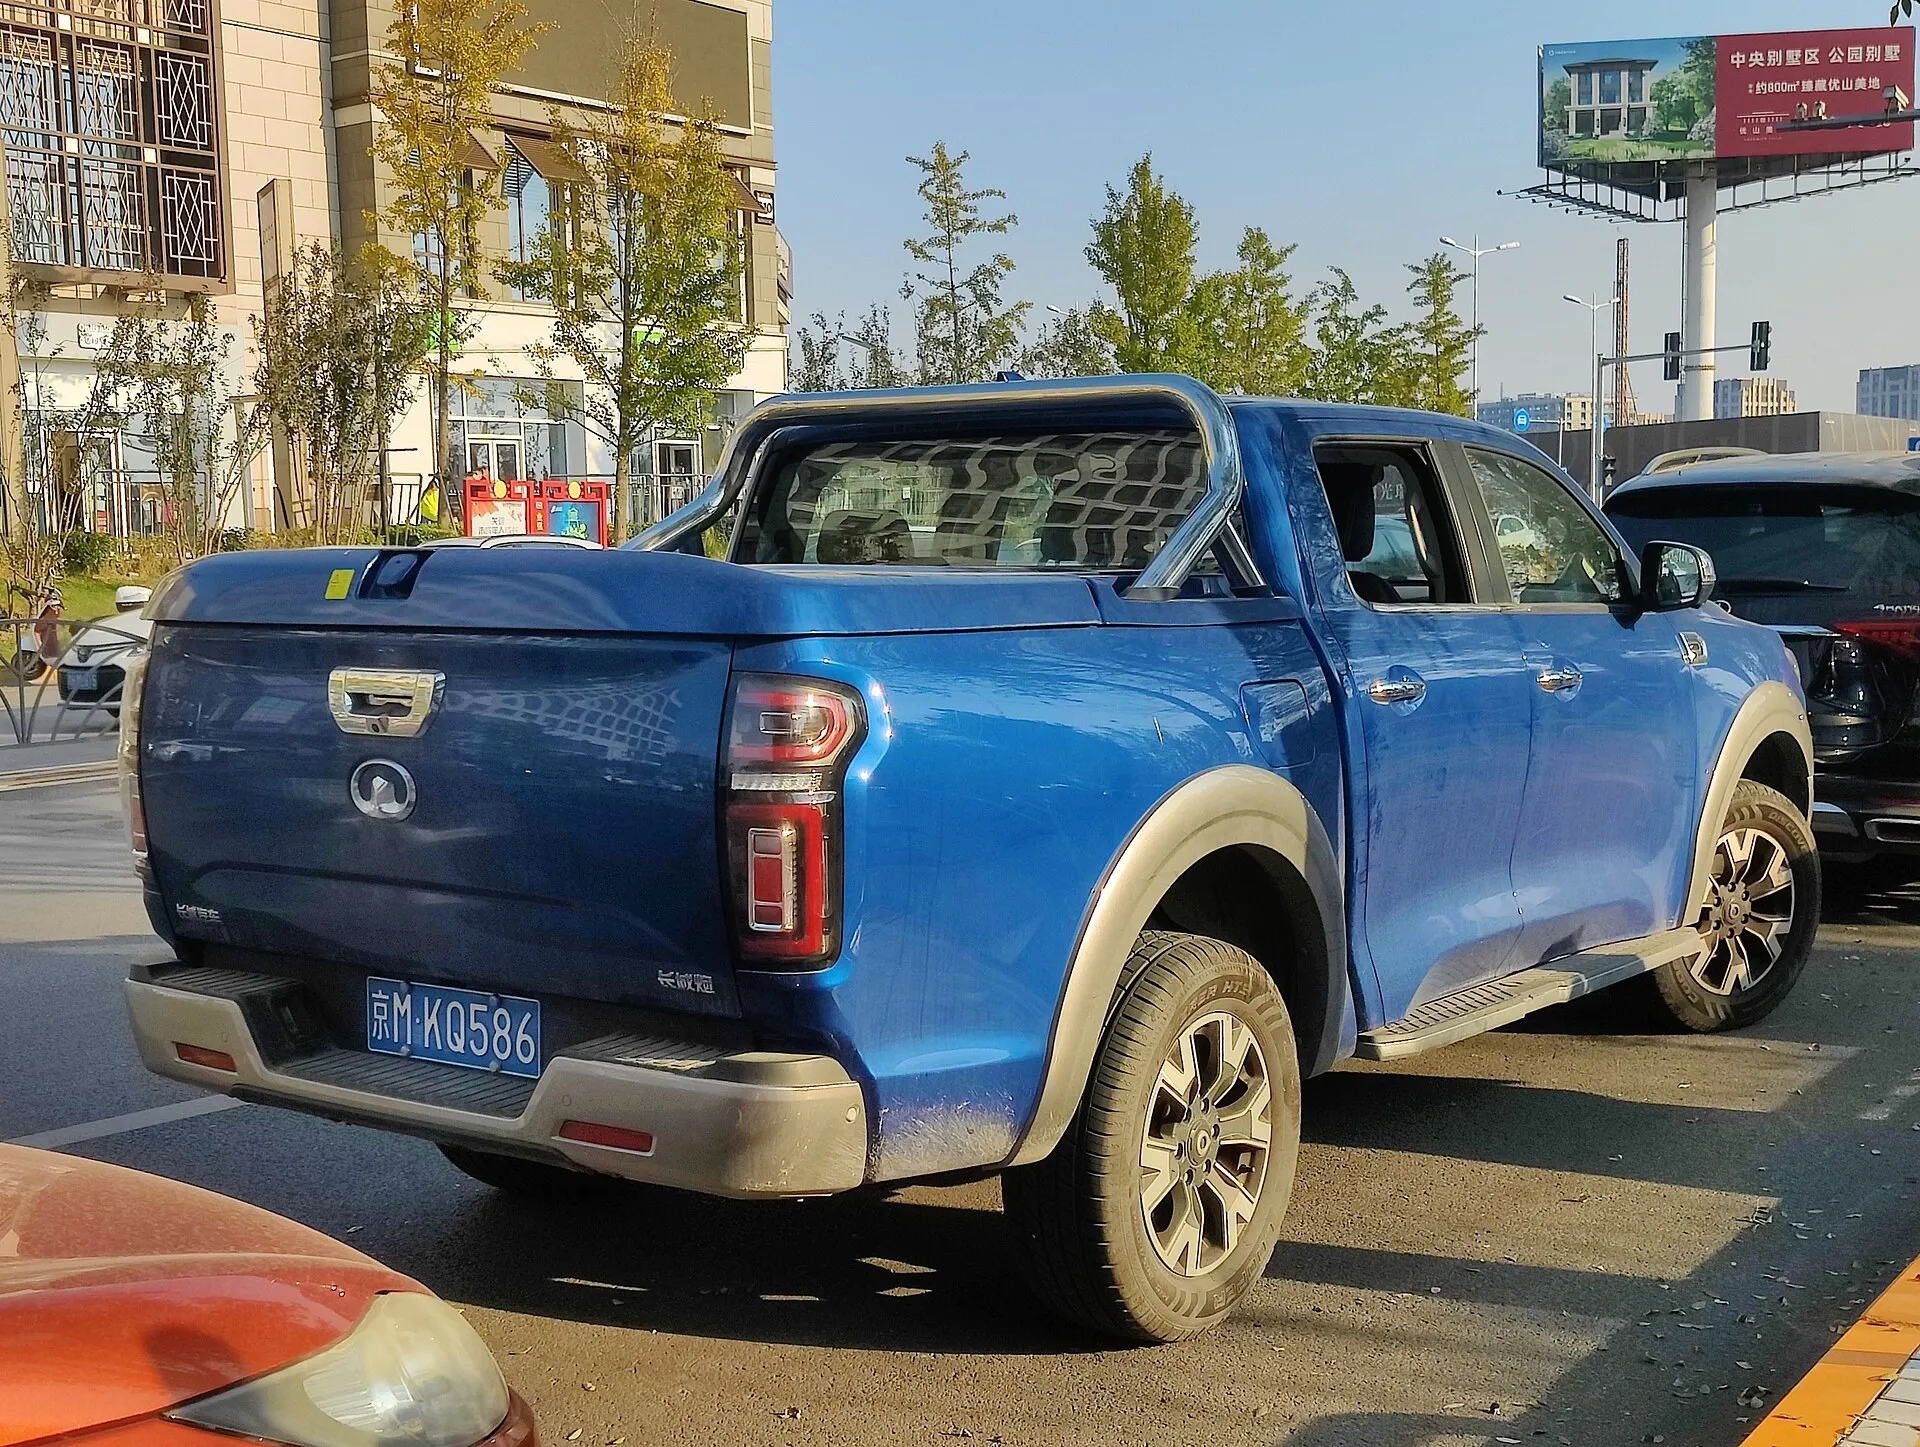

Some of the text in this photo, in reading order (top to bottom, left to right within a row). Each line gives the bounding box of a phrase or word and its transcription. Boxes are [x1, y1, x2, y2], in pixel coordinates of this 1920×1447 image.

[1730, 45, 1901, 69] 中央别墅区 公园别墅
[1739, 126, 1774, 135] 优山美
